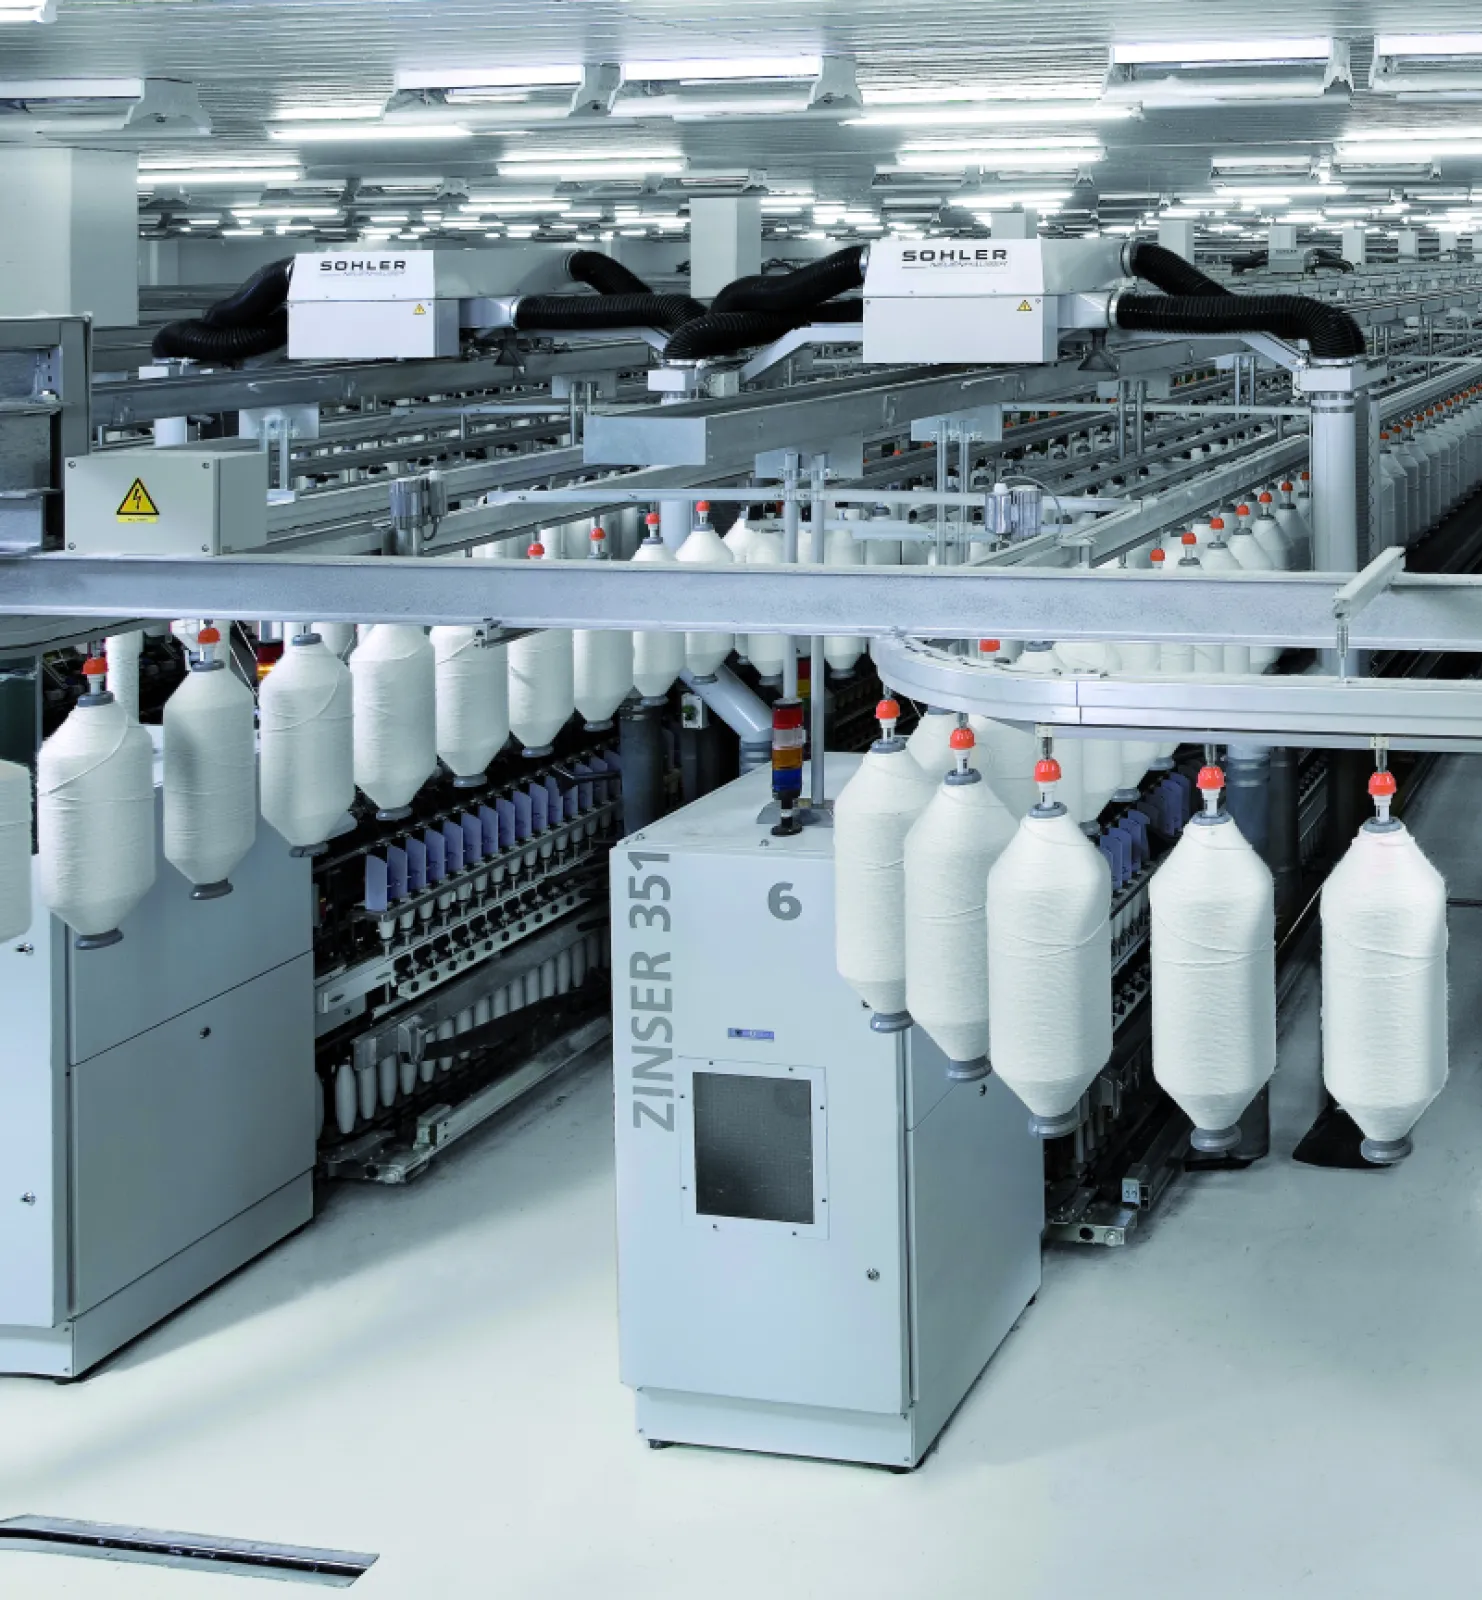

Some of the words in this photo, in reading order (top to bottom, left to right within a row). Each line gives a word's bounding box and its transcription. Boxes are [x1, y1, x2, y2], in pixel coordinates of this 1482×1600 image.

[320, 260, 406, 271] SOHLER
[902, 249, 1007, 262] SOHLER
[627, 851, 671, 932] 351
[767, 881, 803, 921] 6
[630, 951, 675, 1132] ZINSER
